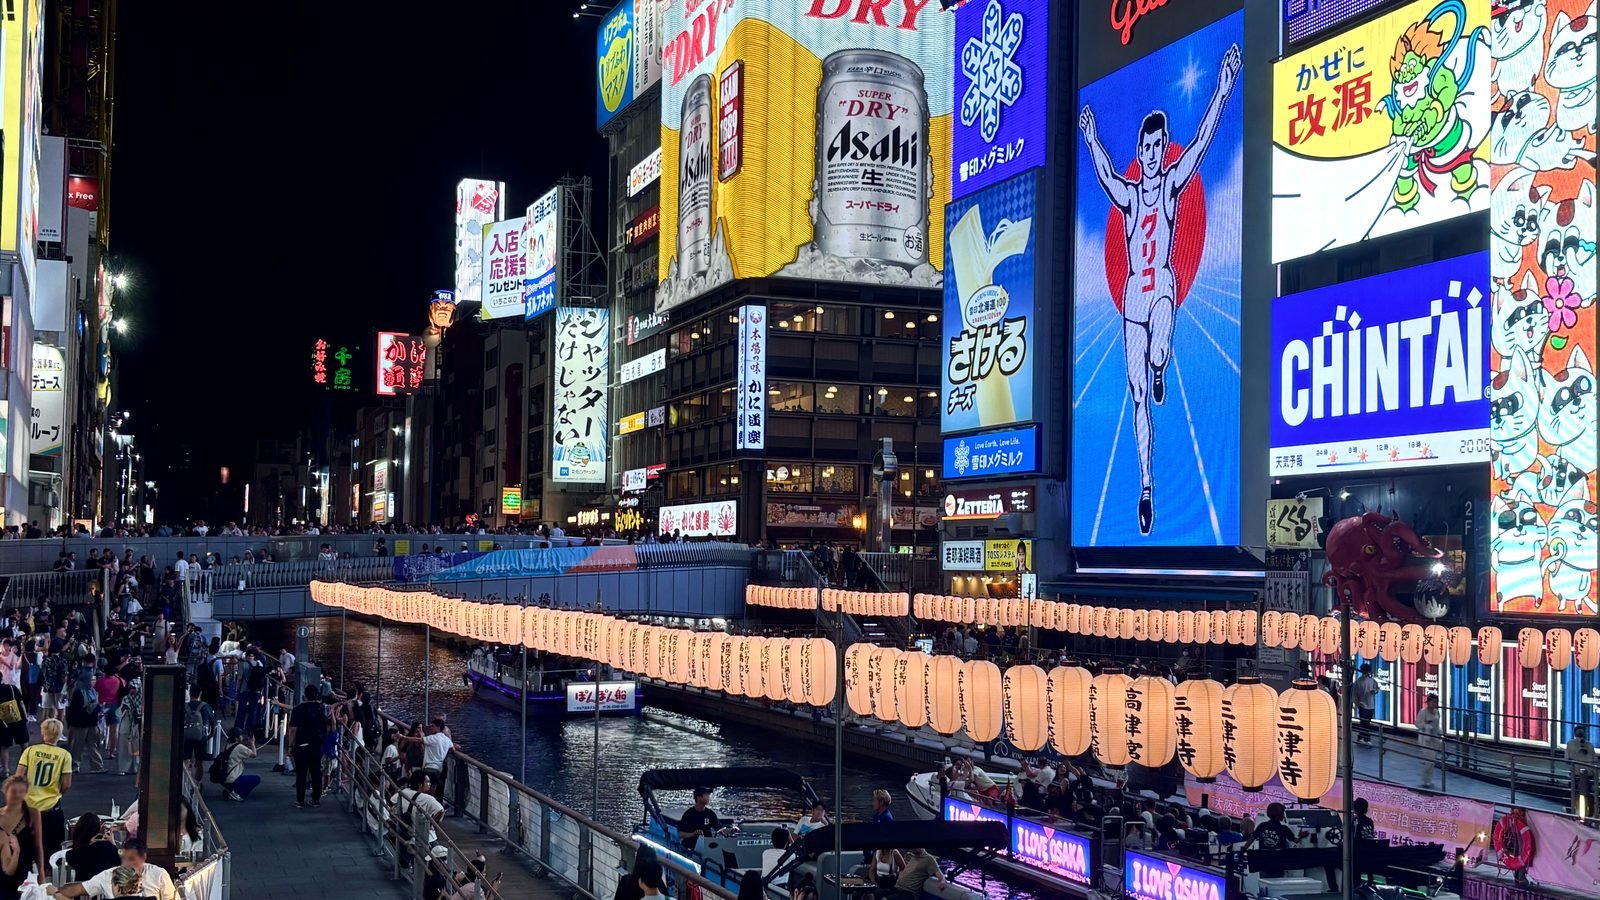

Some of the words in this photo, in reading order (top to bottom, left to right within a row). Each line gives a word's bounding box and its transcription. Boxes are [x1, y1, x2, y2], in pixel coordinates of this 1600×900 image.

[1296, 46, 1366, 92] かぜに
[858, 89, 892, 101] SUPER
[1288, 71, 1373, 146] 改源
[827, 119, 918, 170] Asahi
[959, 137, 1025, 182] 雪印メグミルク
[682, 141, 710, 196] Asahi
[861, 168, 884, 187] 生
[76, 190, 94, 200] Free
[845, 199, 900, 214] スーパードライ
[490, 230, 519, 256] 入店
[904, 232, 923, 253] お酒
[1140, 207, 1158, 293] グリコ
[750, 327, 761, 375] 本場の味
[948, 316, 1027, 385] さける
[555, 313, 582, 445] だけじゃない
[579, 310, 604, 438] シャッター
[748, 380, 761, 444] かに道楽
[948, 384, 977, 415] チーズ
[972, 450, 1023, 471] 雪印メグミルク
[1275, 455, 1303, 469] 天気予報
[682, 510, 710, 531] かに道楽
[957, 497, 1004, 515] ZETTERIA
[1277, 504, 1312, 541] くくる
[1125, 687, 1144, 761] 高津宮
[1174, 696, 1196, 767] 三津寺
[1221, 700, 1238, 771] 三津寺
[1277, 707, 1304, 787] 三津寺
[33, 760, 54, 787] 10
[1017, 826, 1025, 853] I
[1024, 830, 1049, 863] LOVE
[1049, 837, 1087, 875] OSAKA
[1132, 861, 1141, 891] I
[1142, 864, 1173, 900] LOVE
[1174, 876, 1220, 900] OSAKA
